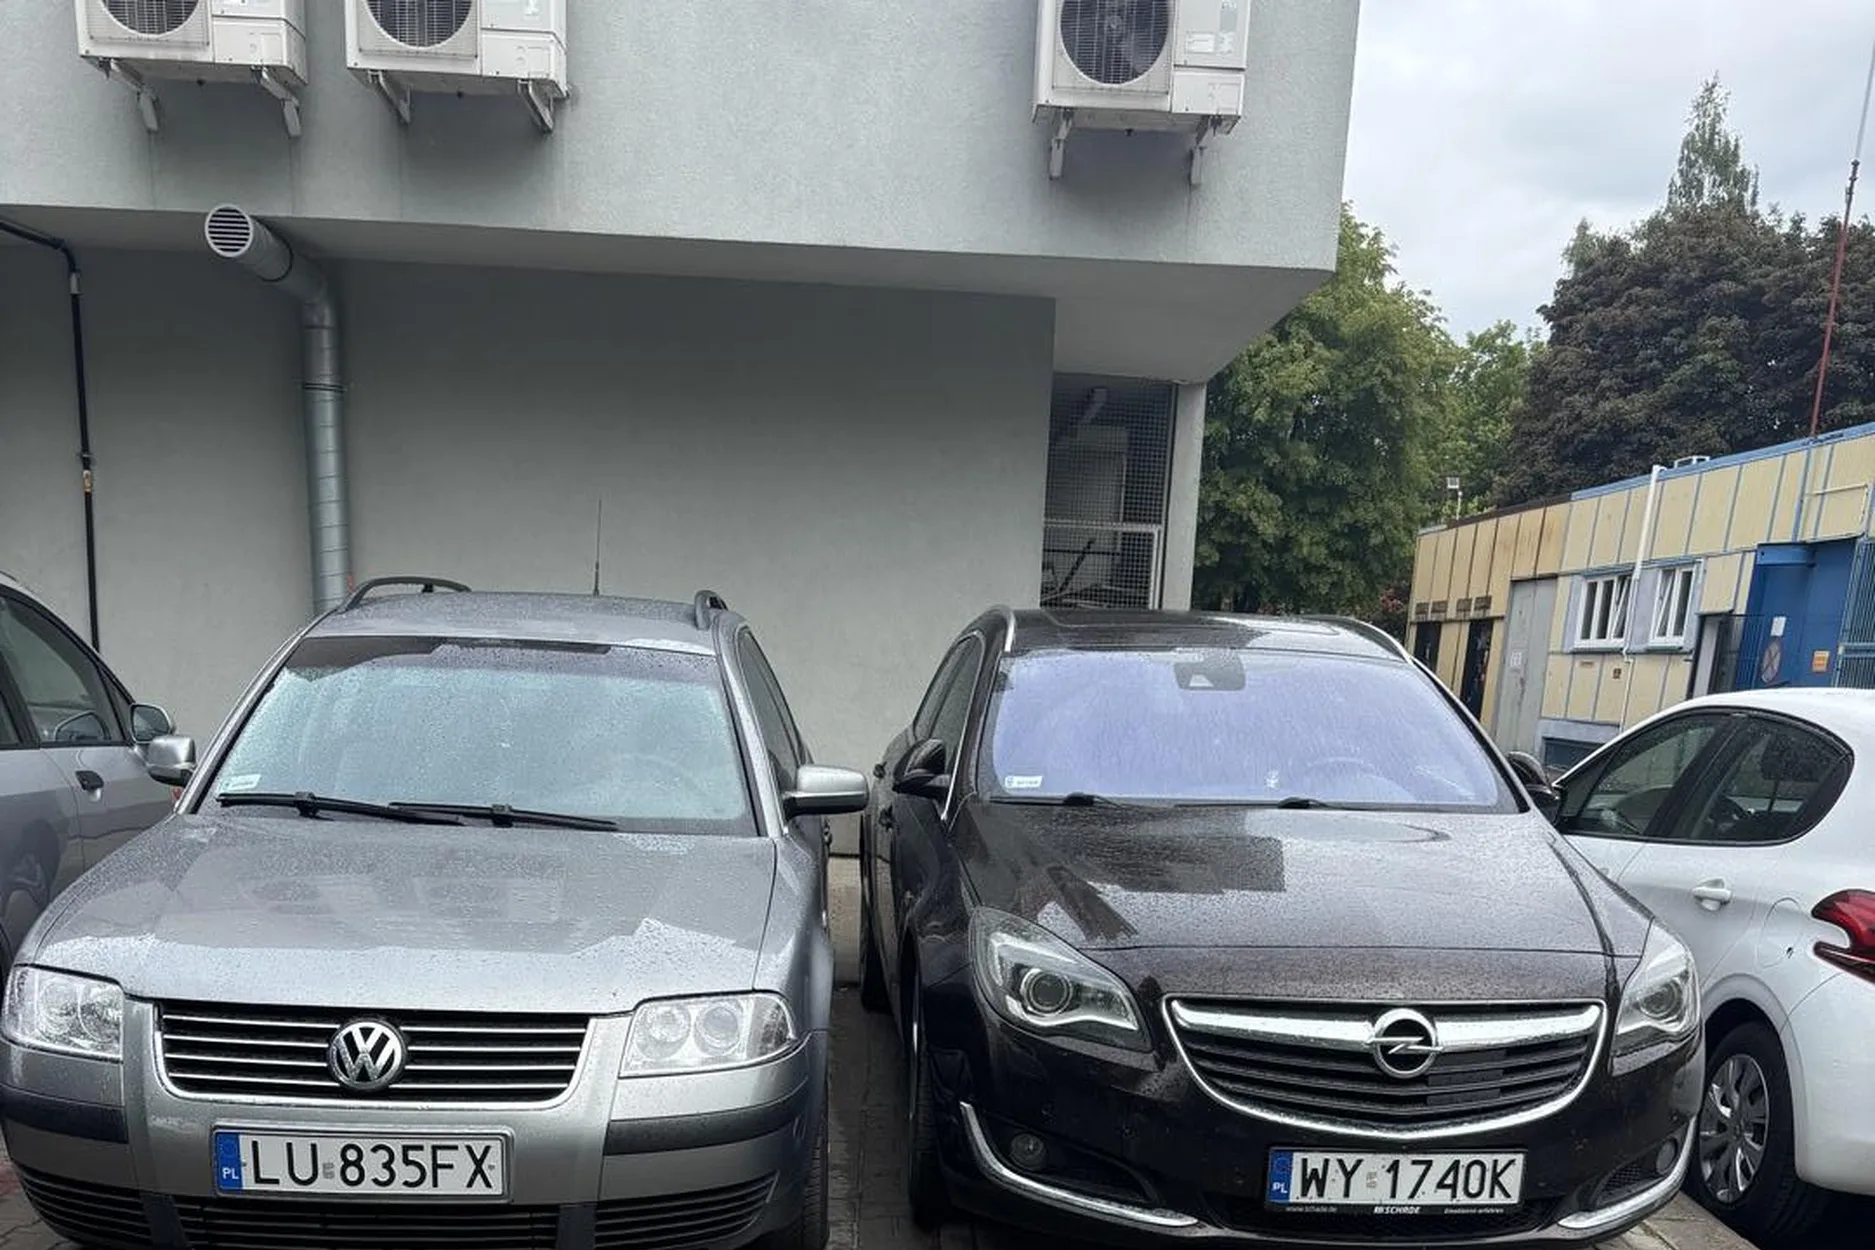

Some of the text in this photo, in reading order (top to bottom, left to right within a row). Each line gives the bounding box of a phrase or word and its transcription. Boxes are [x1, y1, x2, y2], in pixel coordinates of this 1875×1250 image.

[332, 1022, 402, 1089] VW
[222, 1167, 239, 1181] PL
[252, 1140, 493, 1189] LU 835FX
[1300, 1157, 1517, 1200] WY 1740K
[1272, 1181, 1288, 1194] PL
